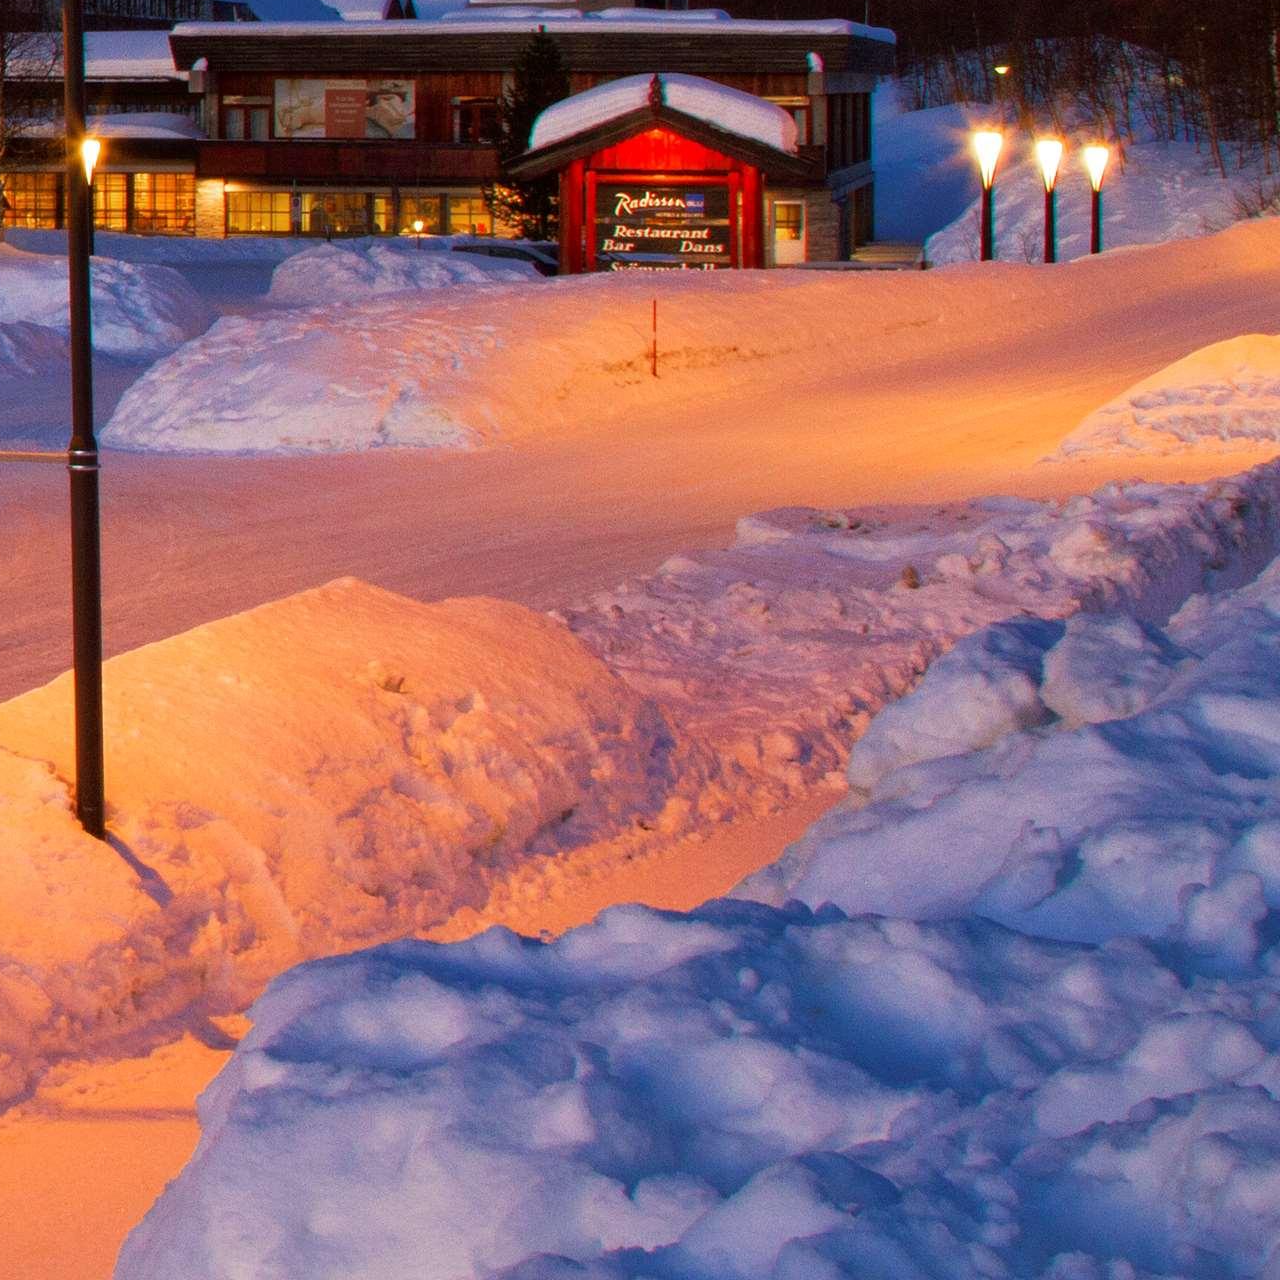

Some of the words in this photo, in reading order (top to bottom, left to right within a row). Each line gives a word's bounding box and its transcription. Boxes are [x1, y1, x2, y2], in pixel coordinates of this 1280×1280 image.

[614, 191, 686, 216] Radisson
[613, 224, 711, 239] Restaurant
[602, 239, 634, 252] Bar
[680, 240, 723, 253] Dans
